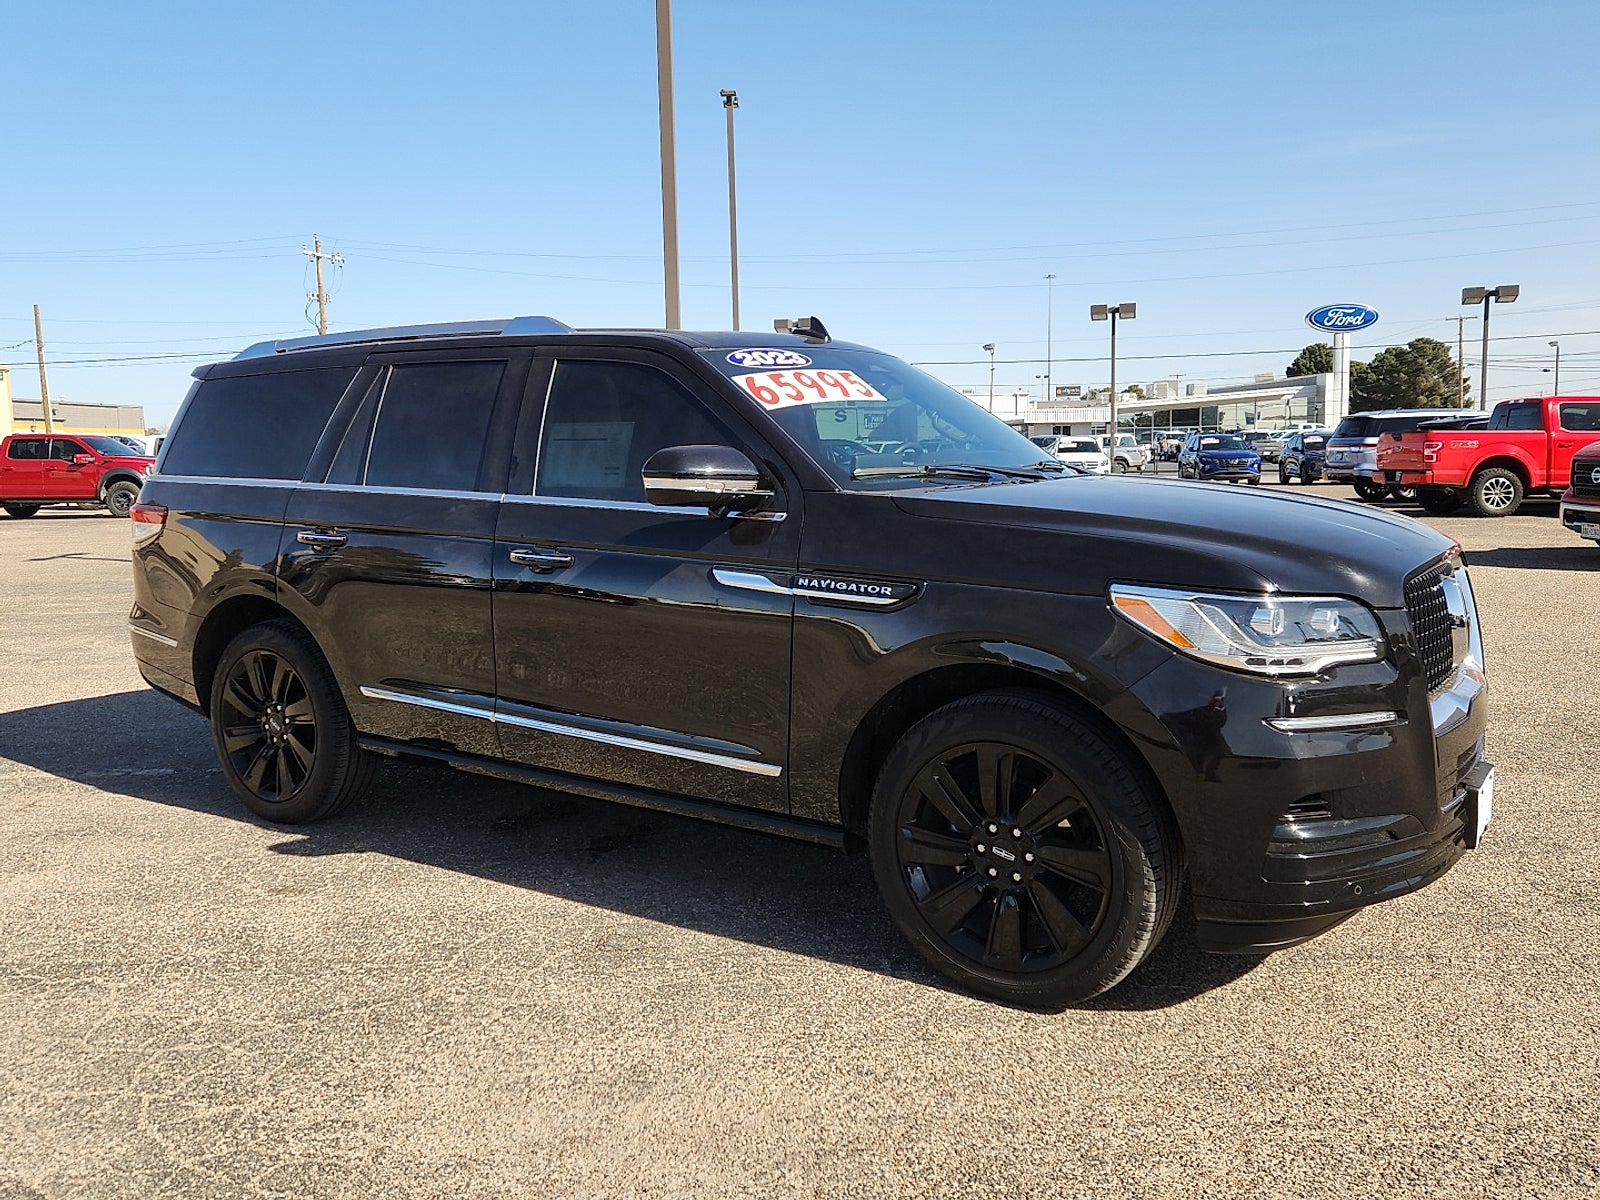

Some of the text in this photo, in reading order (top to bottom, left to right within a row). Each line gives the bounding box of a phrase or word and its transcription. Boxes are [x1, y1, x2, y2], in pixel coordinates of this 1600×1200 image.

[1323, 308, 1366, 326] Ford
[735, 351, 807, 366] 2023
[745, 371, 874, 405] 65995
[797, 577, 893, 596] NAVIGATOR
